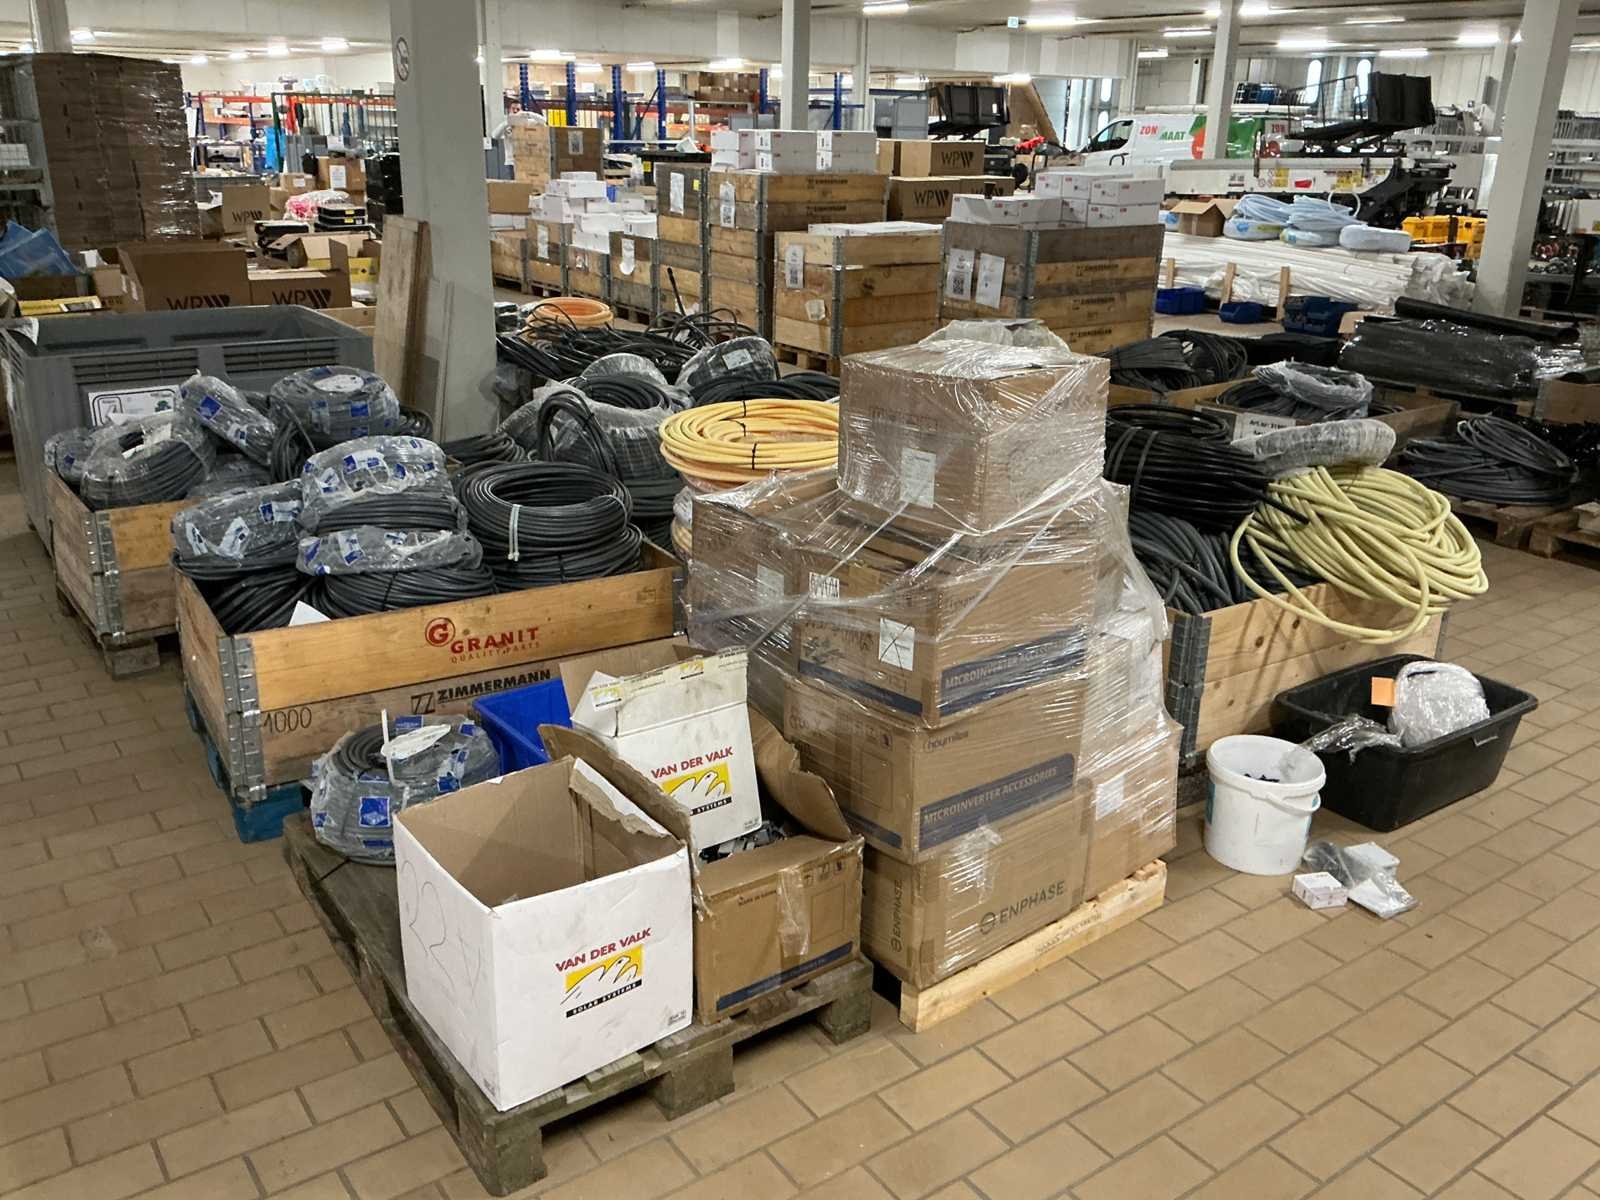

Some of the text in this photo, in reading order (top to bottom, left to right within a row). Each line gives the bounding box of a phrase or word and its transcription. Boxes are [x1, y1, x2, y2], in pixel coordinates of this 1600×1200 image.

[1140, 125, 1158, 135] ZON
[450, 626, 540, 655] GRANIT
[450, 641, 541, 664] QUALITY PARTS
[437, 669, 551, 701] ZIMMERMANN
[651, 746, 733, 780] VAN DER VALK
[924, 767, 1058, 826] MICROINVERTER ACCESSORIES
[999, 880, 1065, 924] ENPHASE
[555, 927, 651, 972] VAN DER VALK
